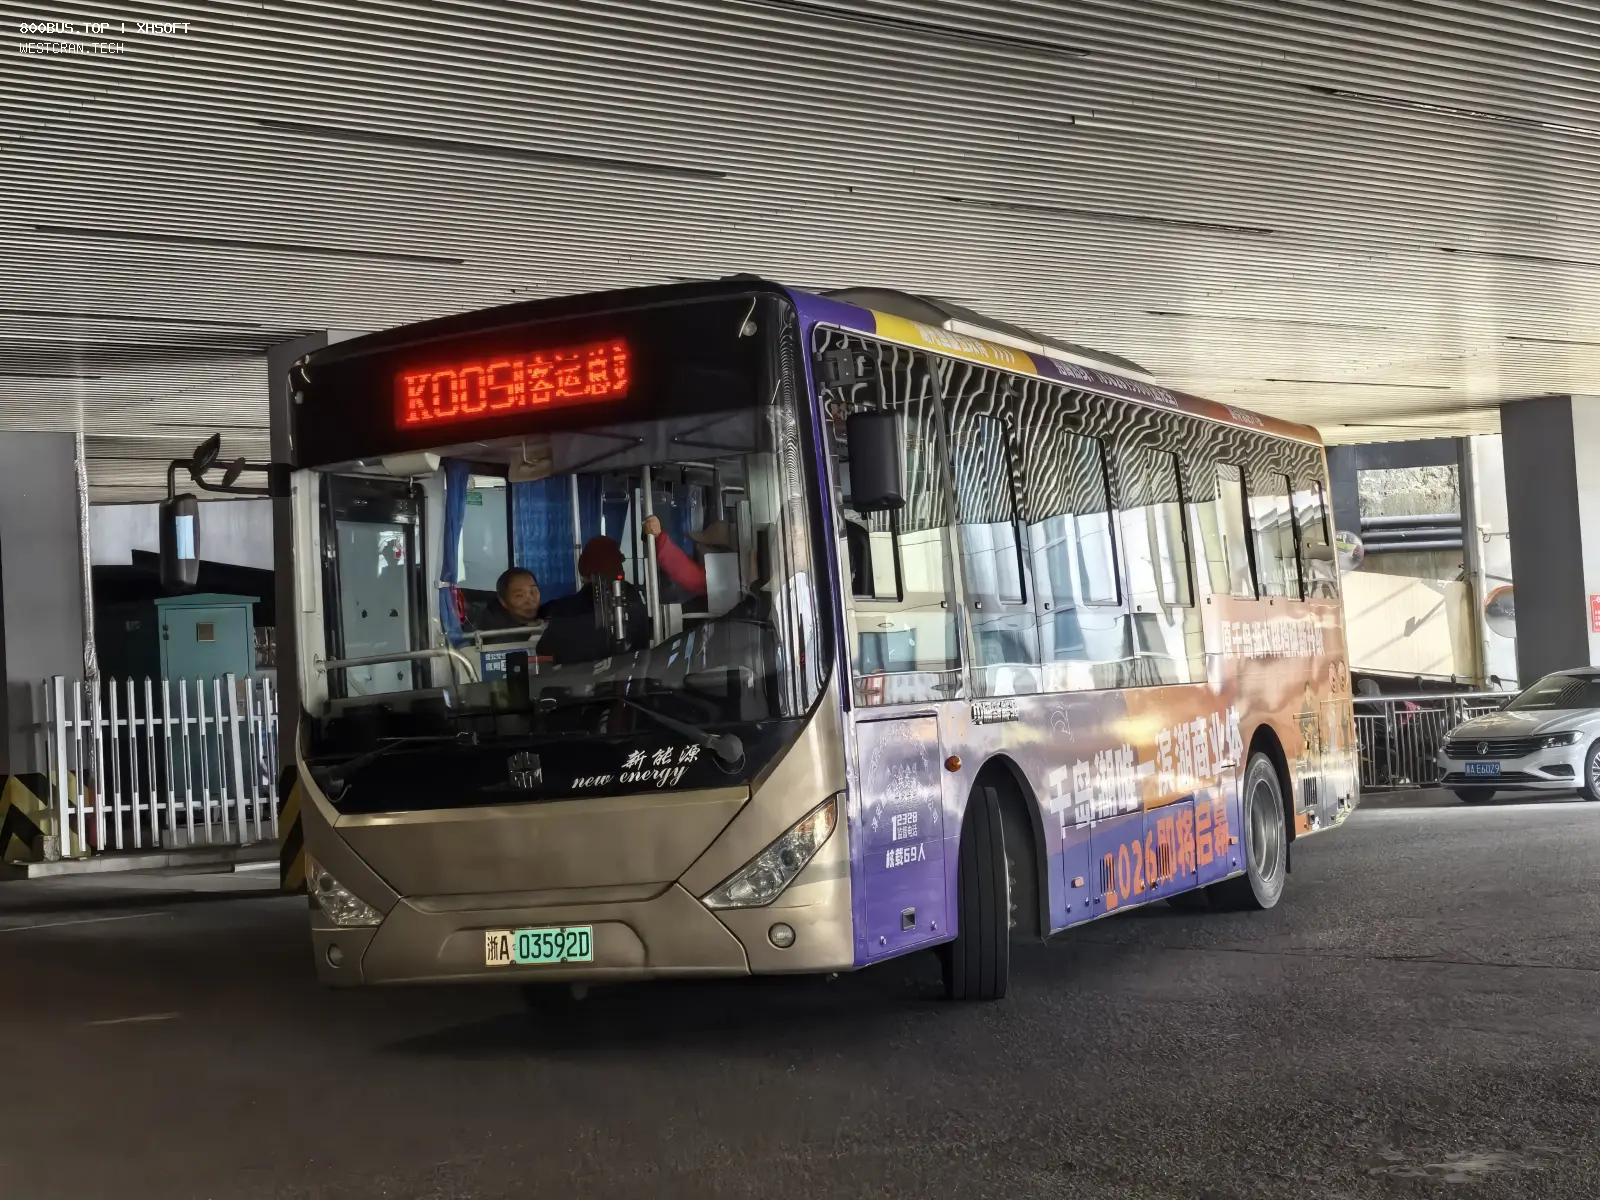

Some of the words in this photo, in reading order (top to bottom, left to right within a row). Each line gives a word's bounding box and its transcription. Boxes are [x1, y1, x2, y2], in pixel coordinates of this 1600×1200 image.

[621, 743, 701, 770] 新能源
[571, 774, 615, 789] new
[619, 766, 690, 788] energy
[891, 811, 918, 841] 12328
[885, 842, 926, 868] 核载69人
[519, 931, 590, 959] 03592D
